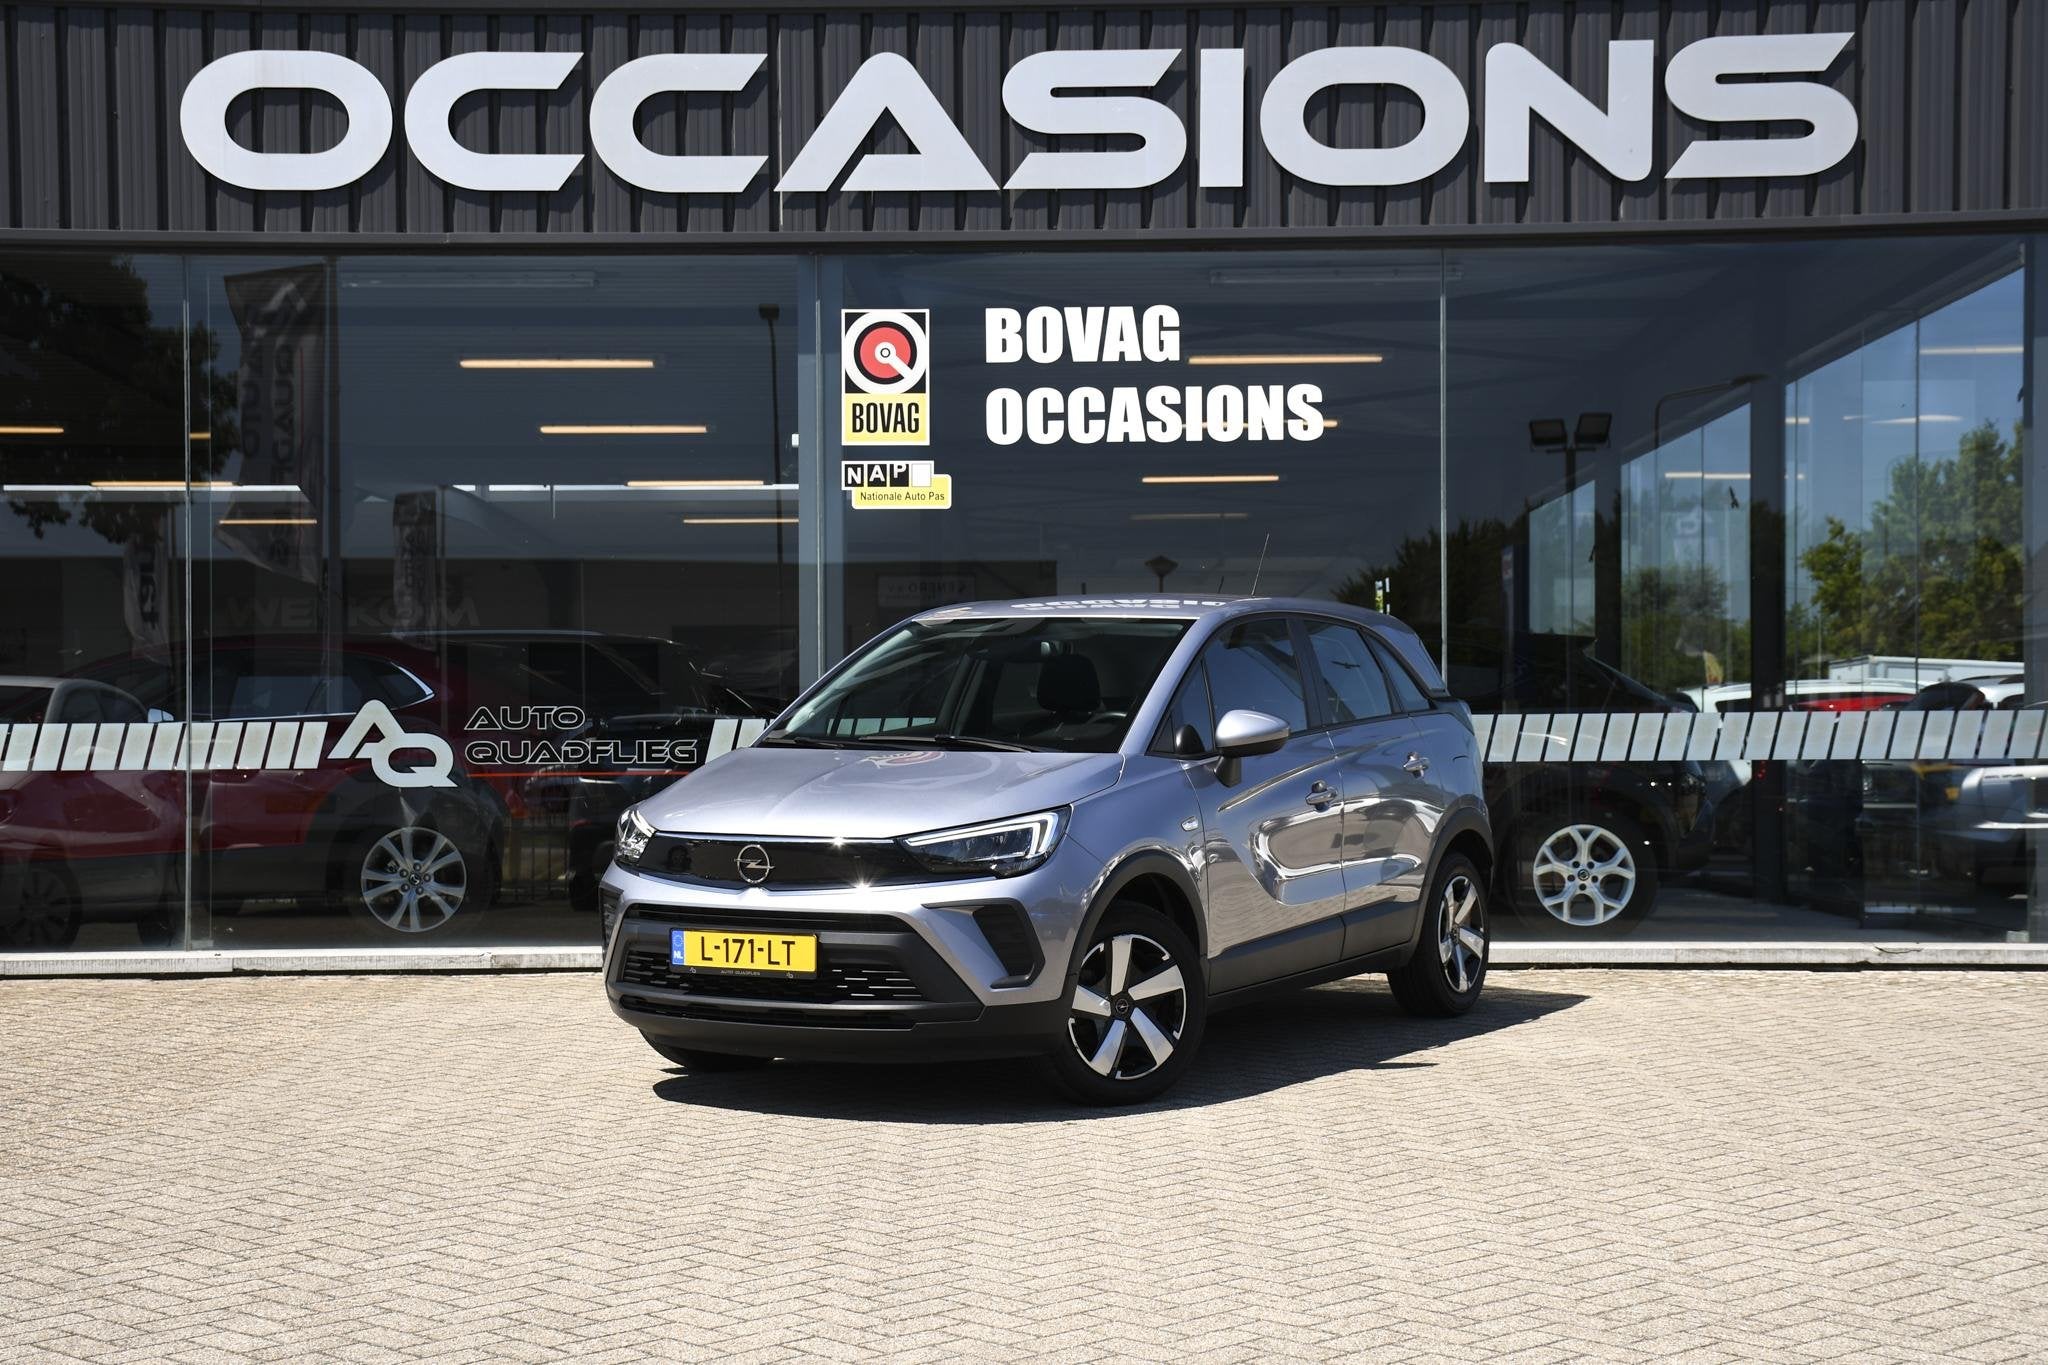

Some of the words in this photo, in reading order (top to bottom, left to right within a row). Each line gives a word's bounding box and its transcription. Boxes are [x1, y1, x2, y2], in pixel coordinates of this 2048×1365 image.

[179, 32, 1859, 193] OCCASIONS
[985, 304, 1181, 364] BOVAG
[851, 402, 920, 434] BOVAG
[985, 383, 1325, 445] OCCASIONS
[847, 463, 907, 485] NAP
[860, 491, 902, 501] Nationale
[904, 491, 926, 501] Auto
[928, 491, 945, 501] Pas
[225, 597, 480, 627] WEKOM
[464, 705, 586, 731] AUTO
[327, 699, 458, 788] AQ
[464, 739, 698, 765] QUADFLIEG
[673, 950, 683, 959] NL
[701, 936, 796, 966] L-171-LT
